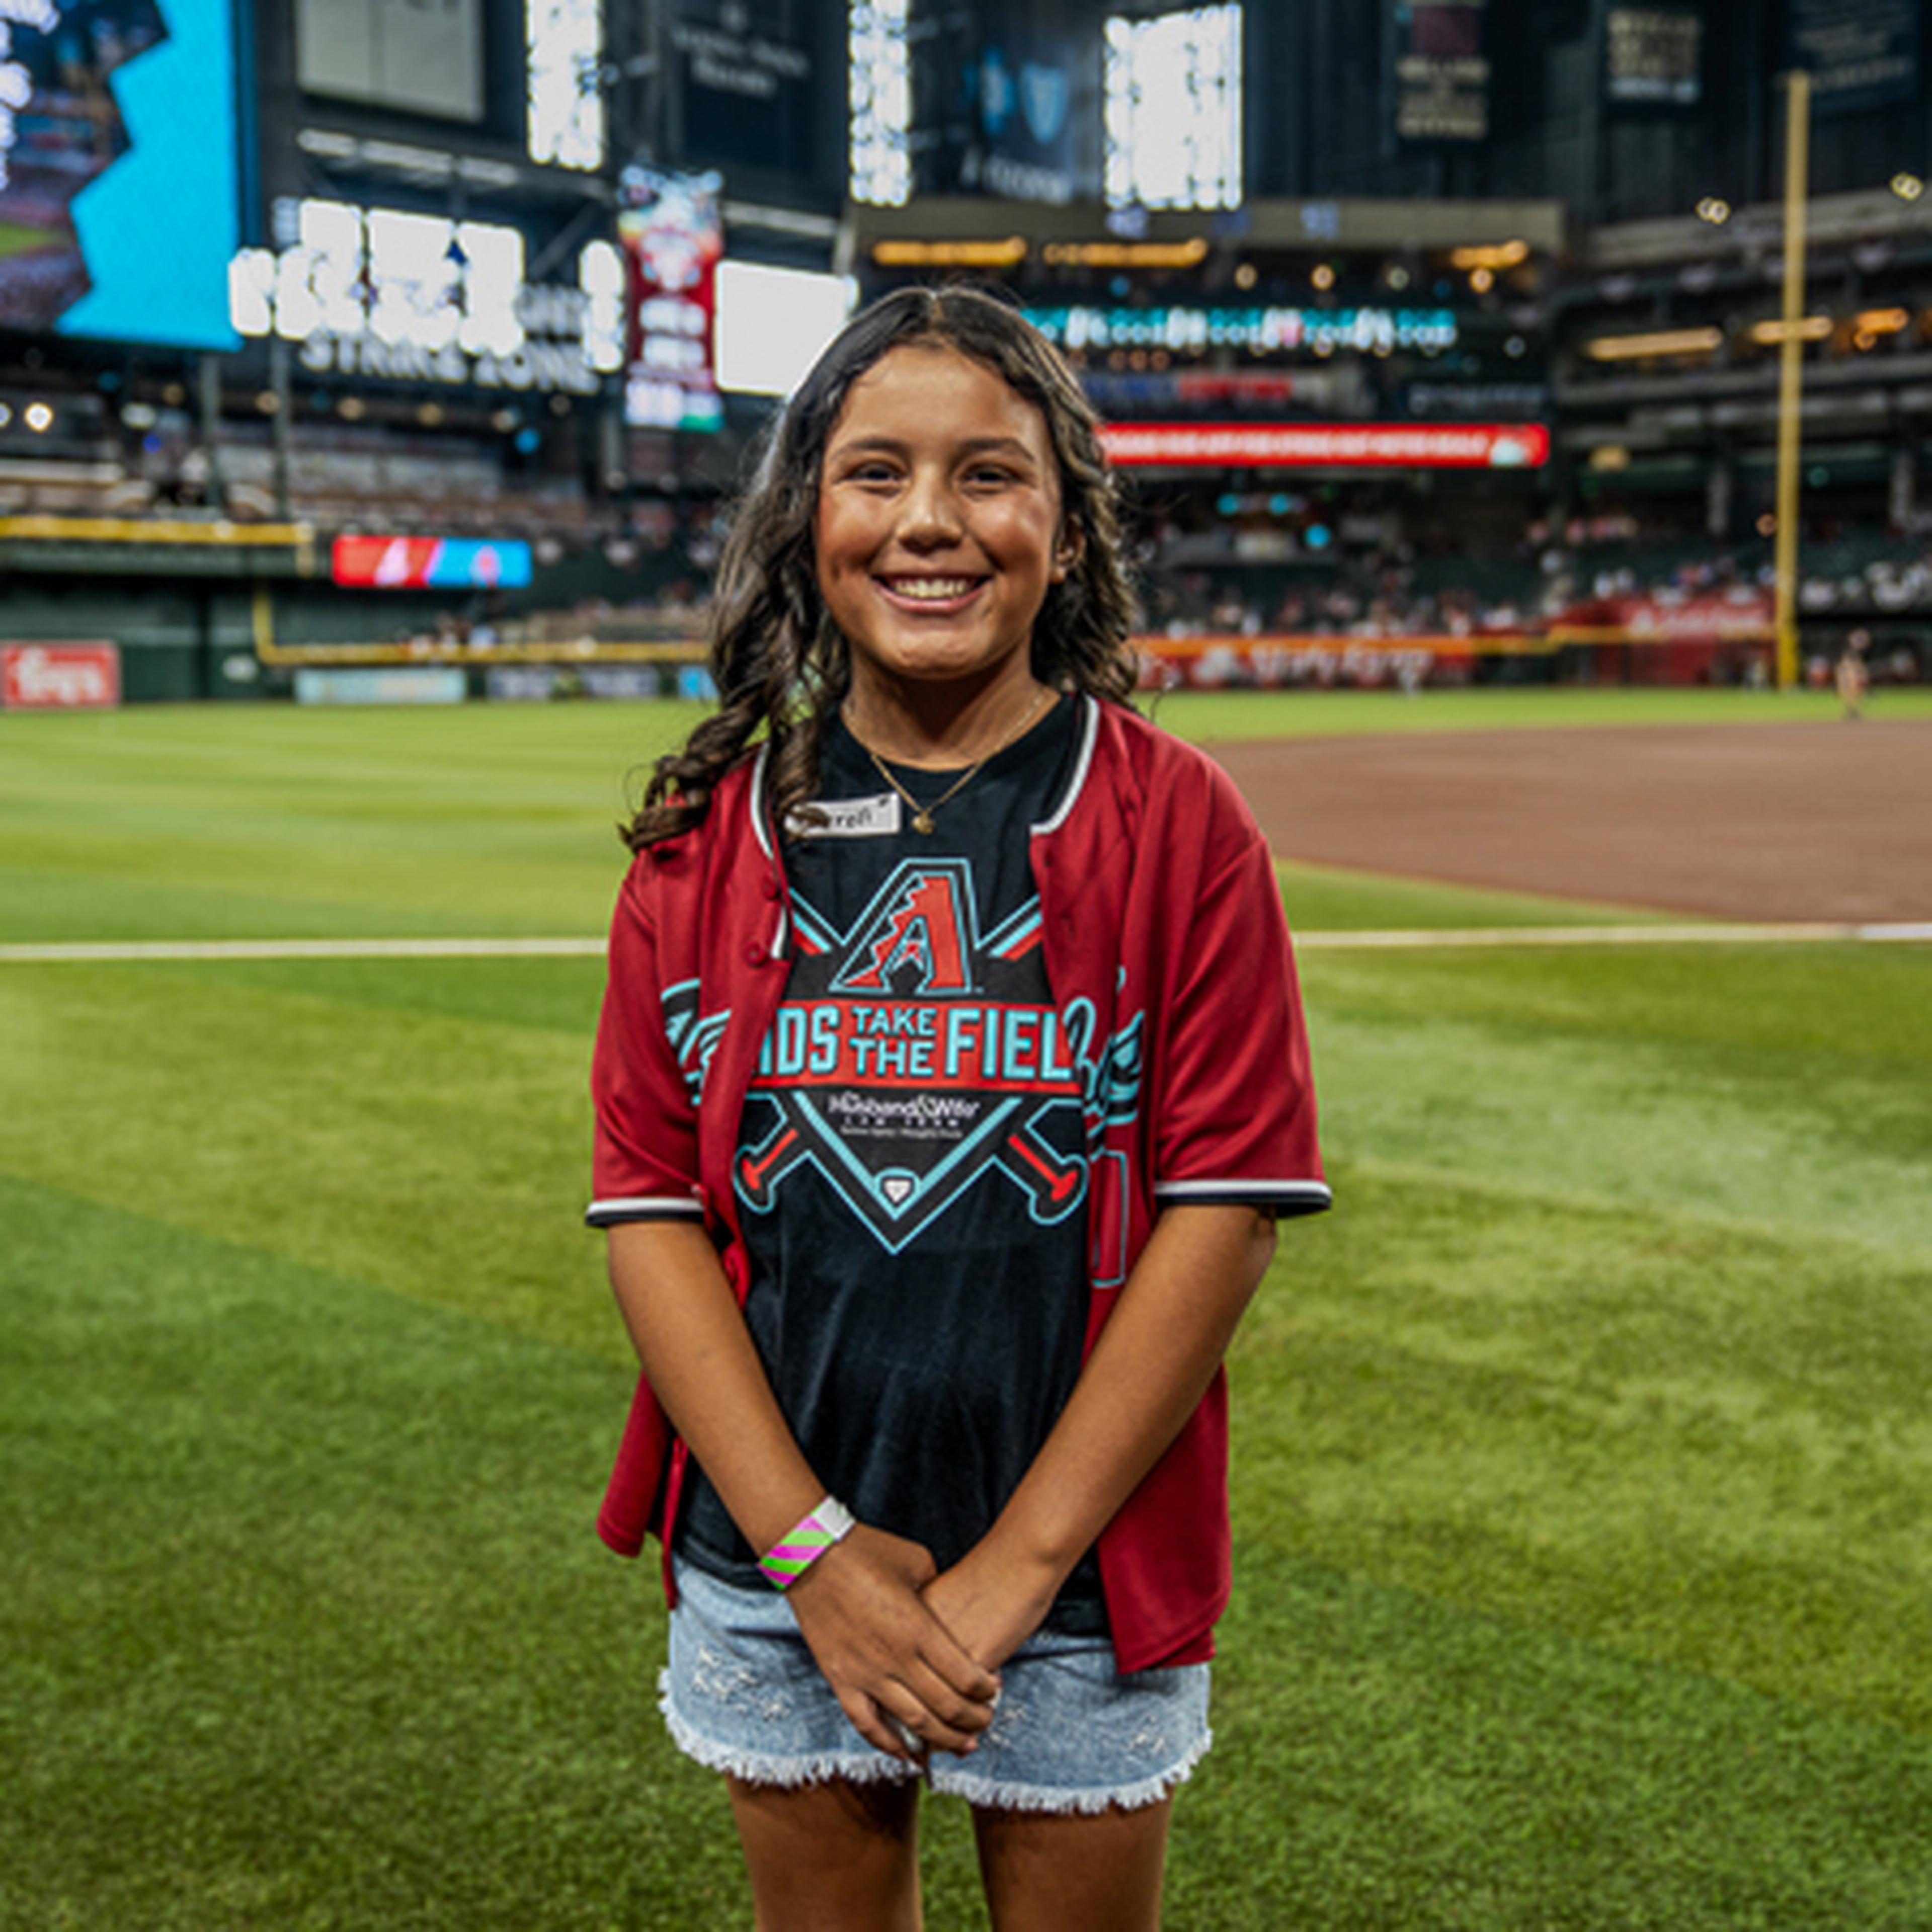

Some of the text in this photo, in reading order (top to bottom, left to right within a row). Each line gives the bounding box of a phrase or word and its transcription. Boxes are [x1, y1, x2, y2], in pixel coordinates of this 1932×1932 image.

[759, 1006, 839, 1076] IDS
[850, 1007, 937, 1037] TAKE
[945, 1007, 1072, 1081] FIEL
[849, 1038, 936, 1076] THE
